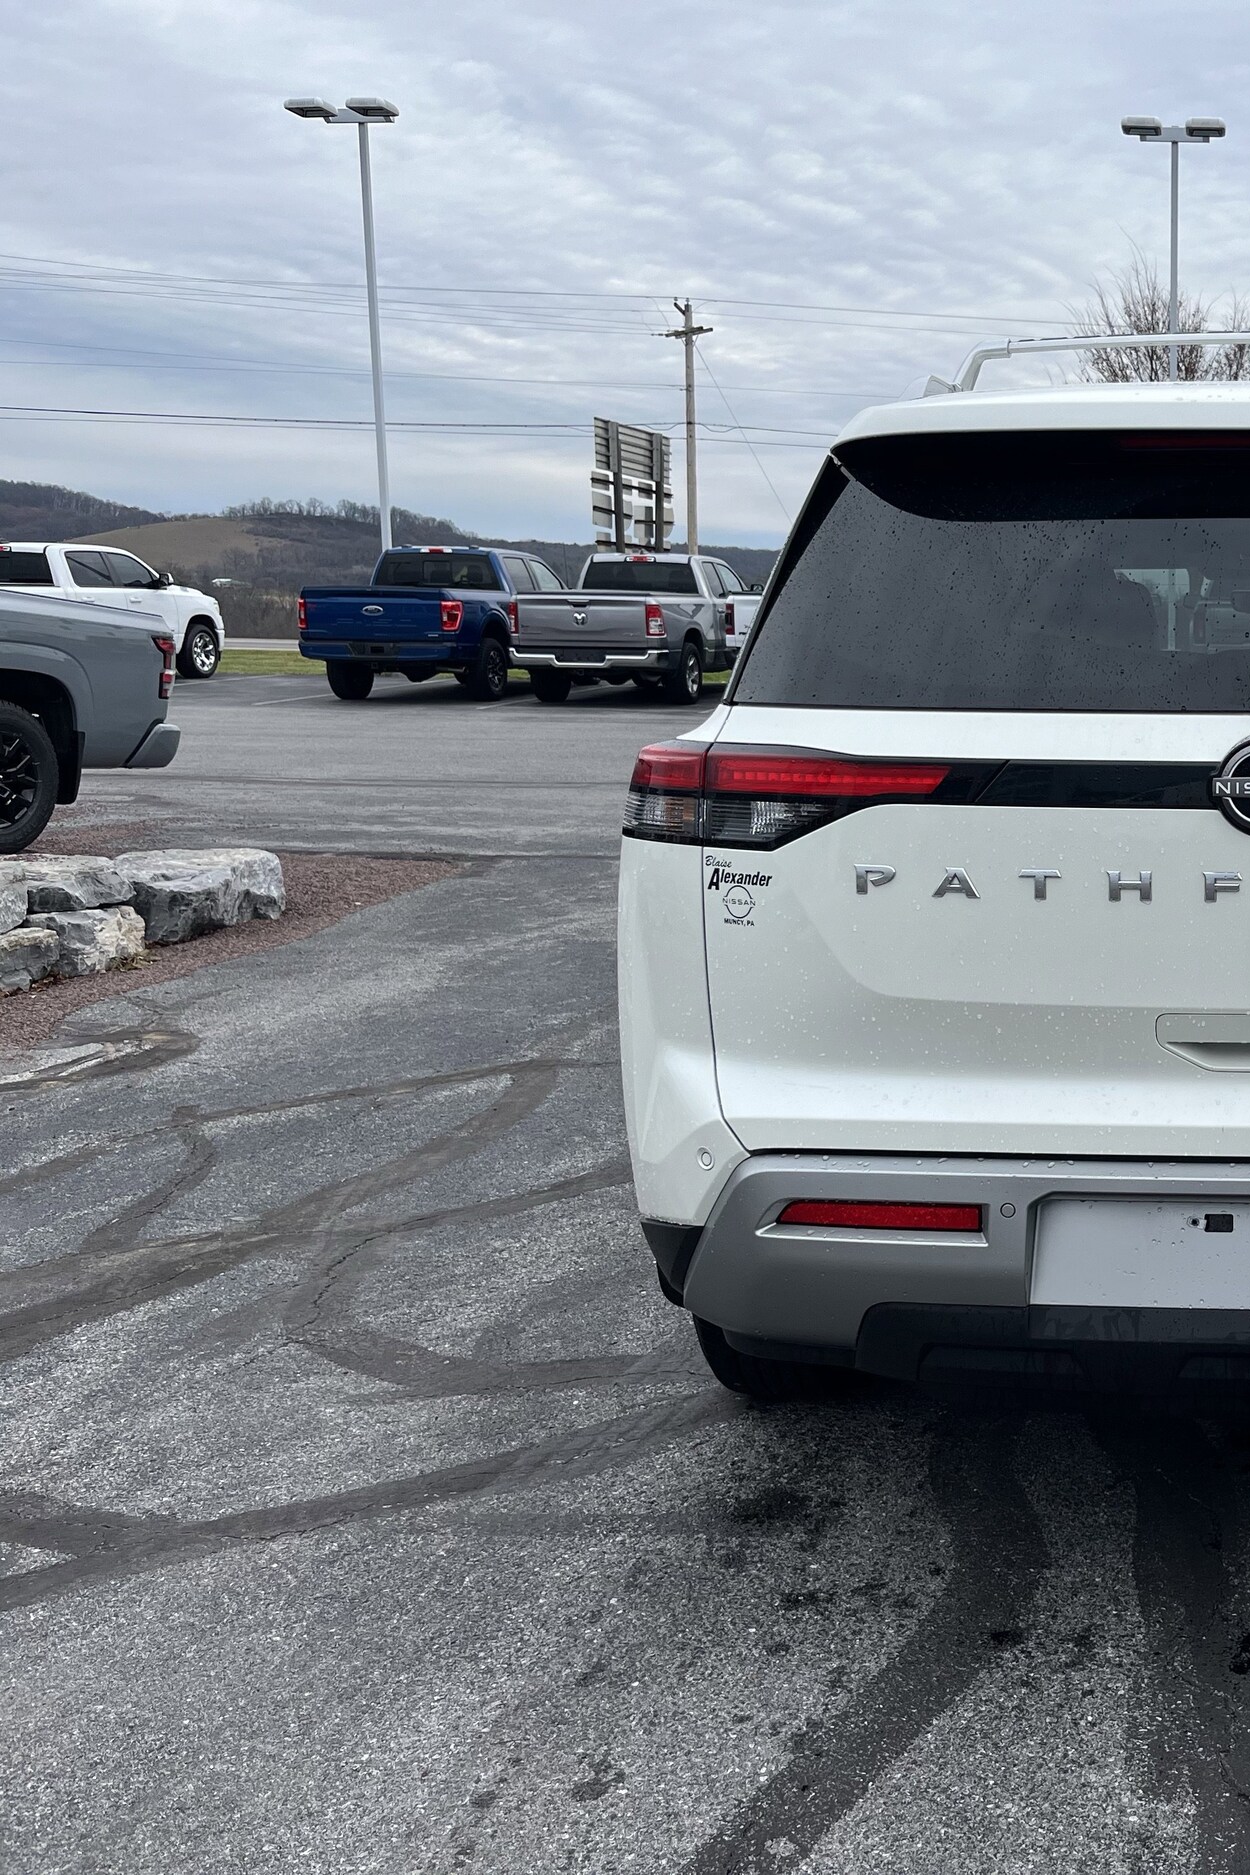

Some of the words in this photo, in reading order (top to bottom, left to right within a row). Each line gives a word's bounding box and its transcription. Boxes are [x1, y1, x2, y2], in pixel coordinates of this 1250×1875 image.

[704, 855, 733, 868] Blaise
[707, 867, 773, 891] Alexander
[722, 897, 756, 906] NISSAN
[723, 918, 746, 927] MUNCY,
[746, 919, 755, 927] PA
